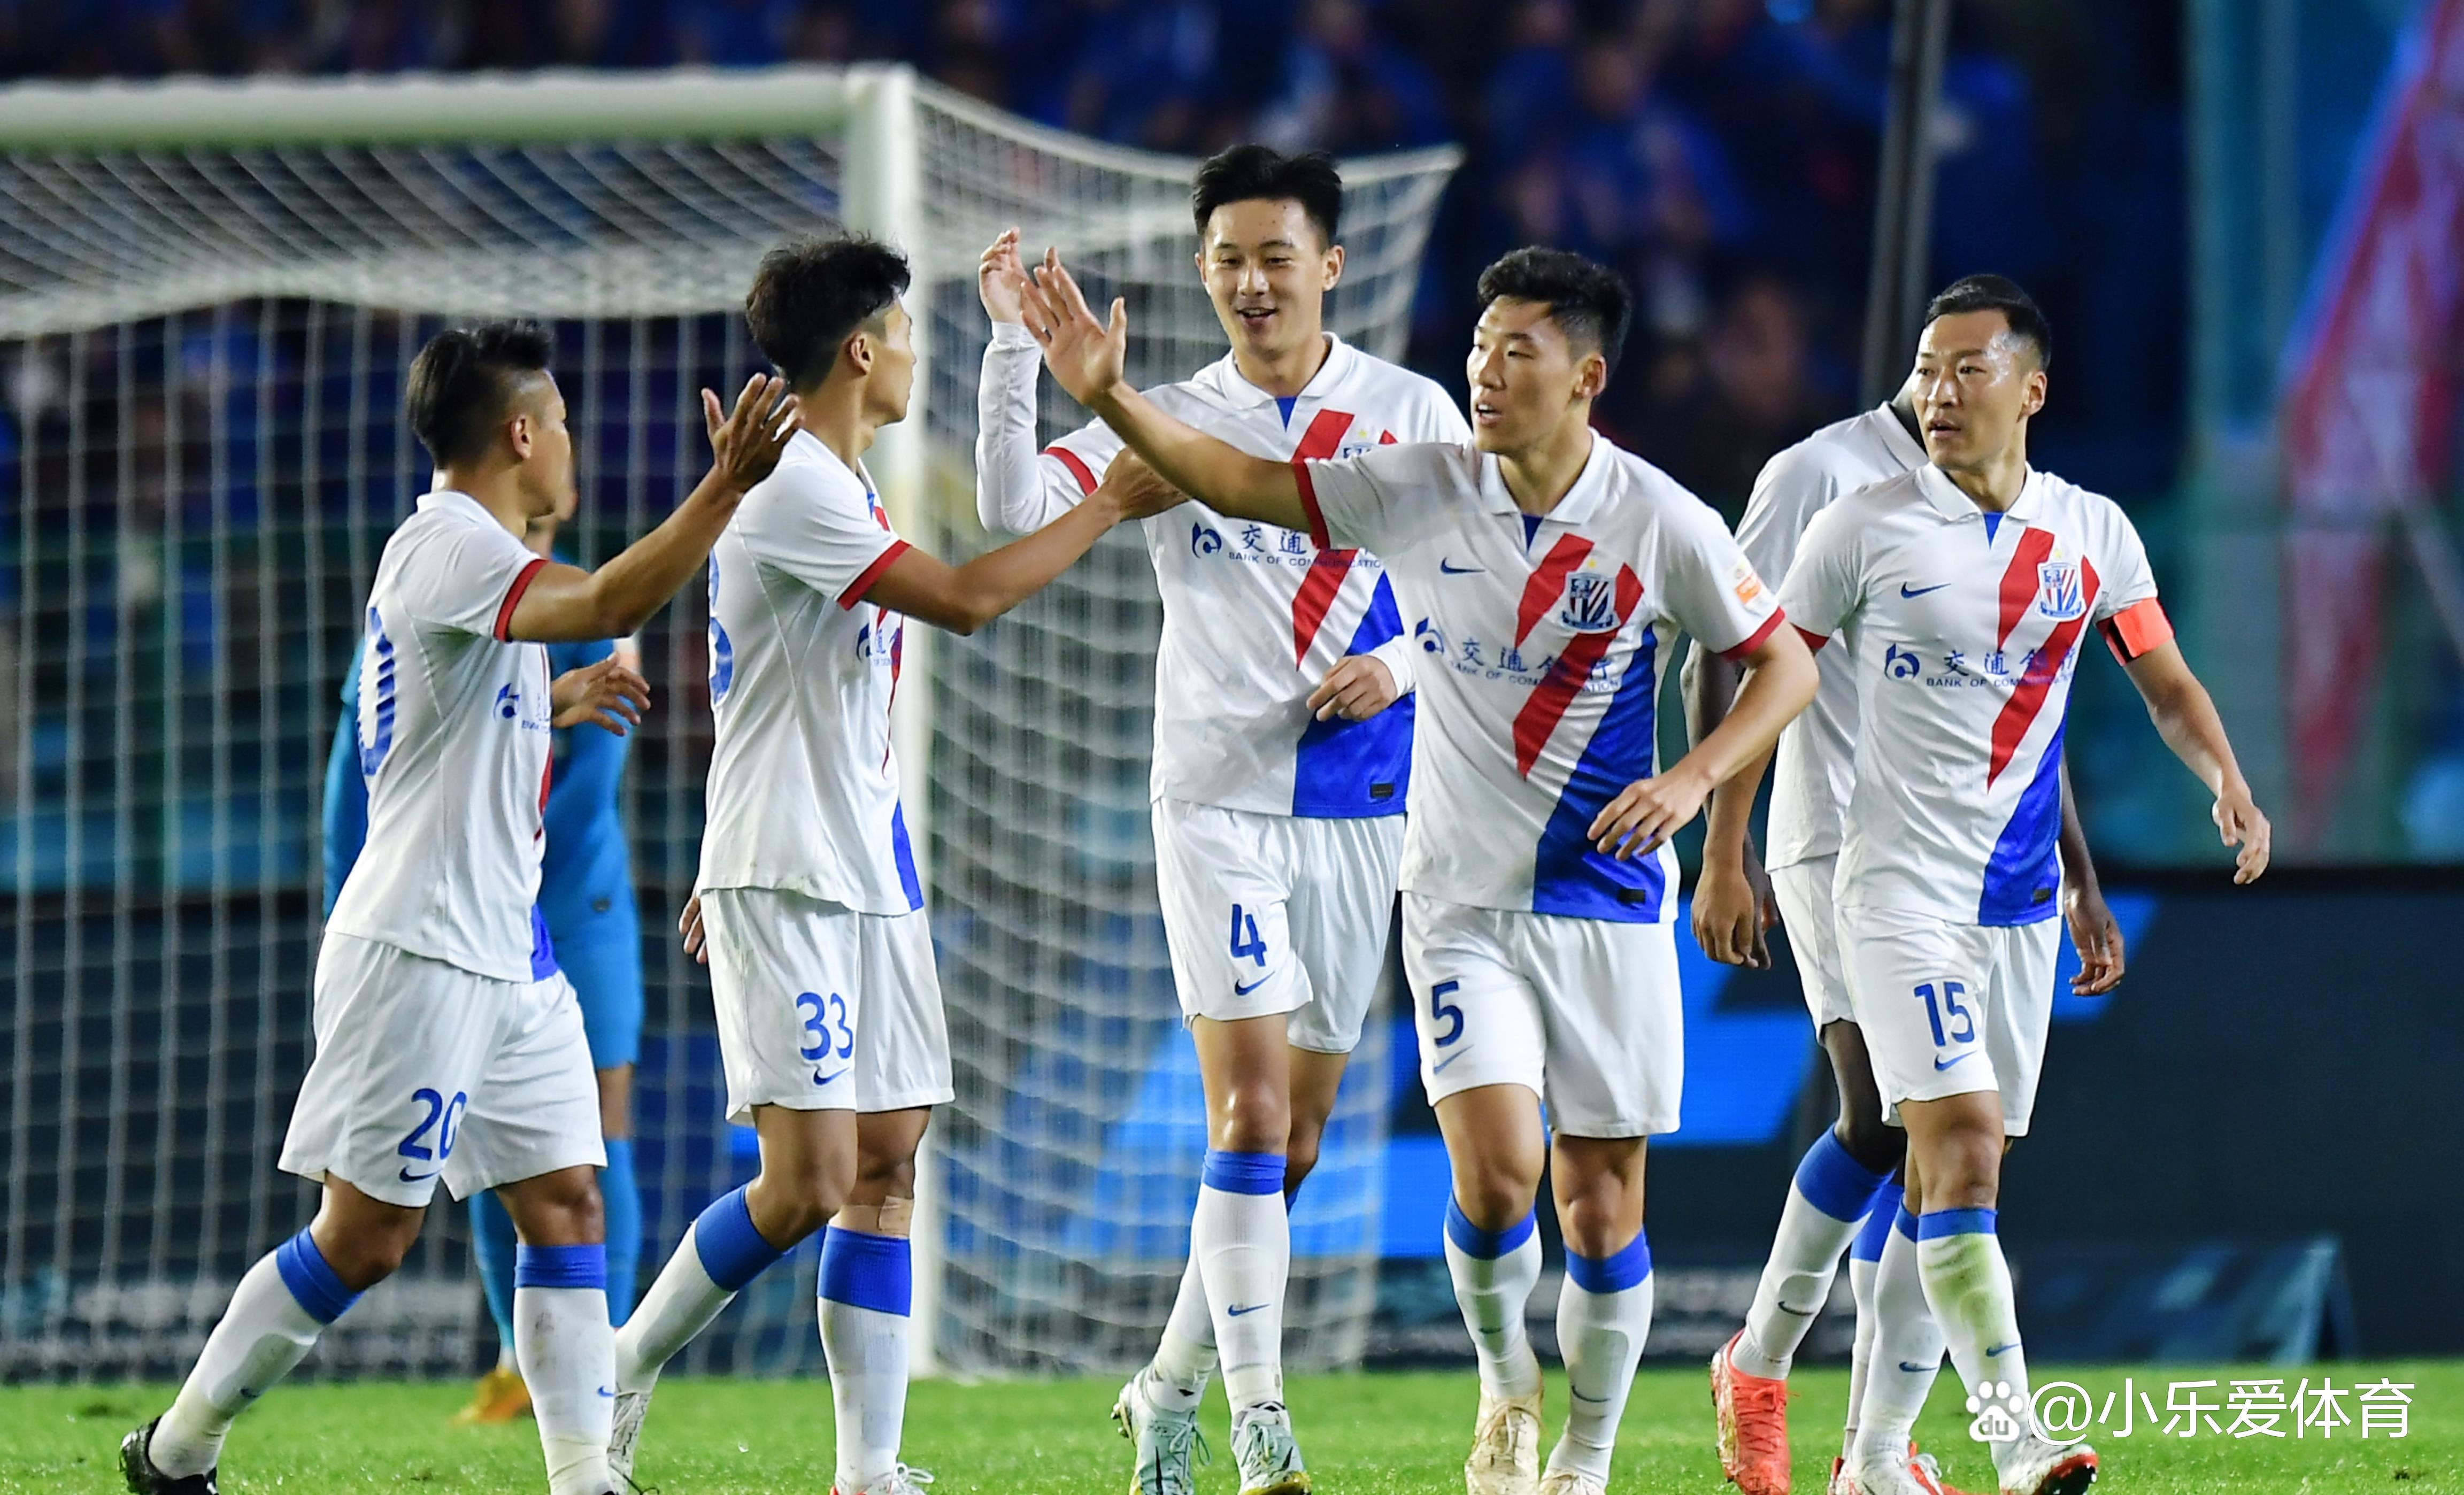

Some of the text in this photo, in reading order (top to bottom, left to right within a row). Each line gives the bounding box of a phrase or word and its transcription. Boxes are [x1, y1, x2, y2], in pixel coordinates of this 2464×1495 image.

[1266, 556, 1284, 565] OF
[1450, 660, 1478, 675] ANK
[1486, 671, 1503, 679] OF
[1926, 677, 1962, 687] BANK
[1970, 679, 1988, 688] OF
[1230, 903, 1267, 967] 4
[796, 992, 853, 1061] 33
[1431, 980, 1464, 1049] 5
[1913, 981, 1975, 1047] 15
[397, 1088, 467, 1161] 20
